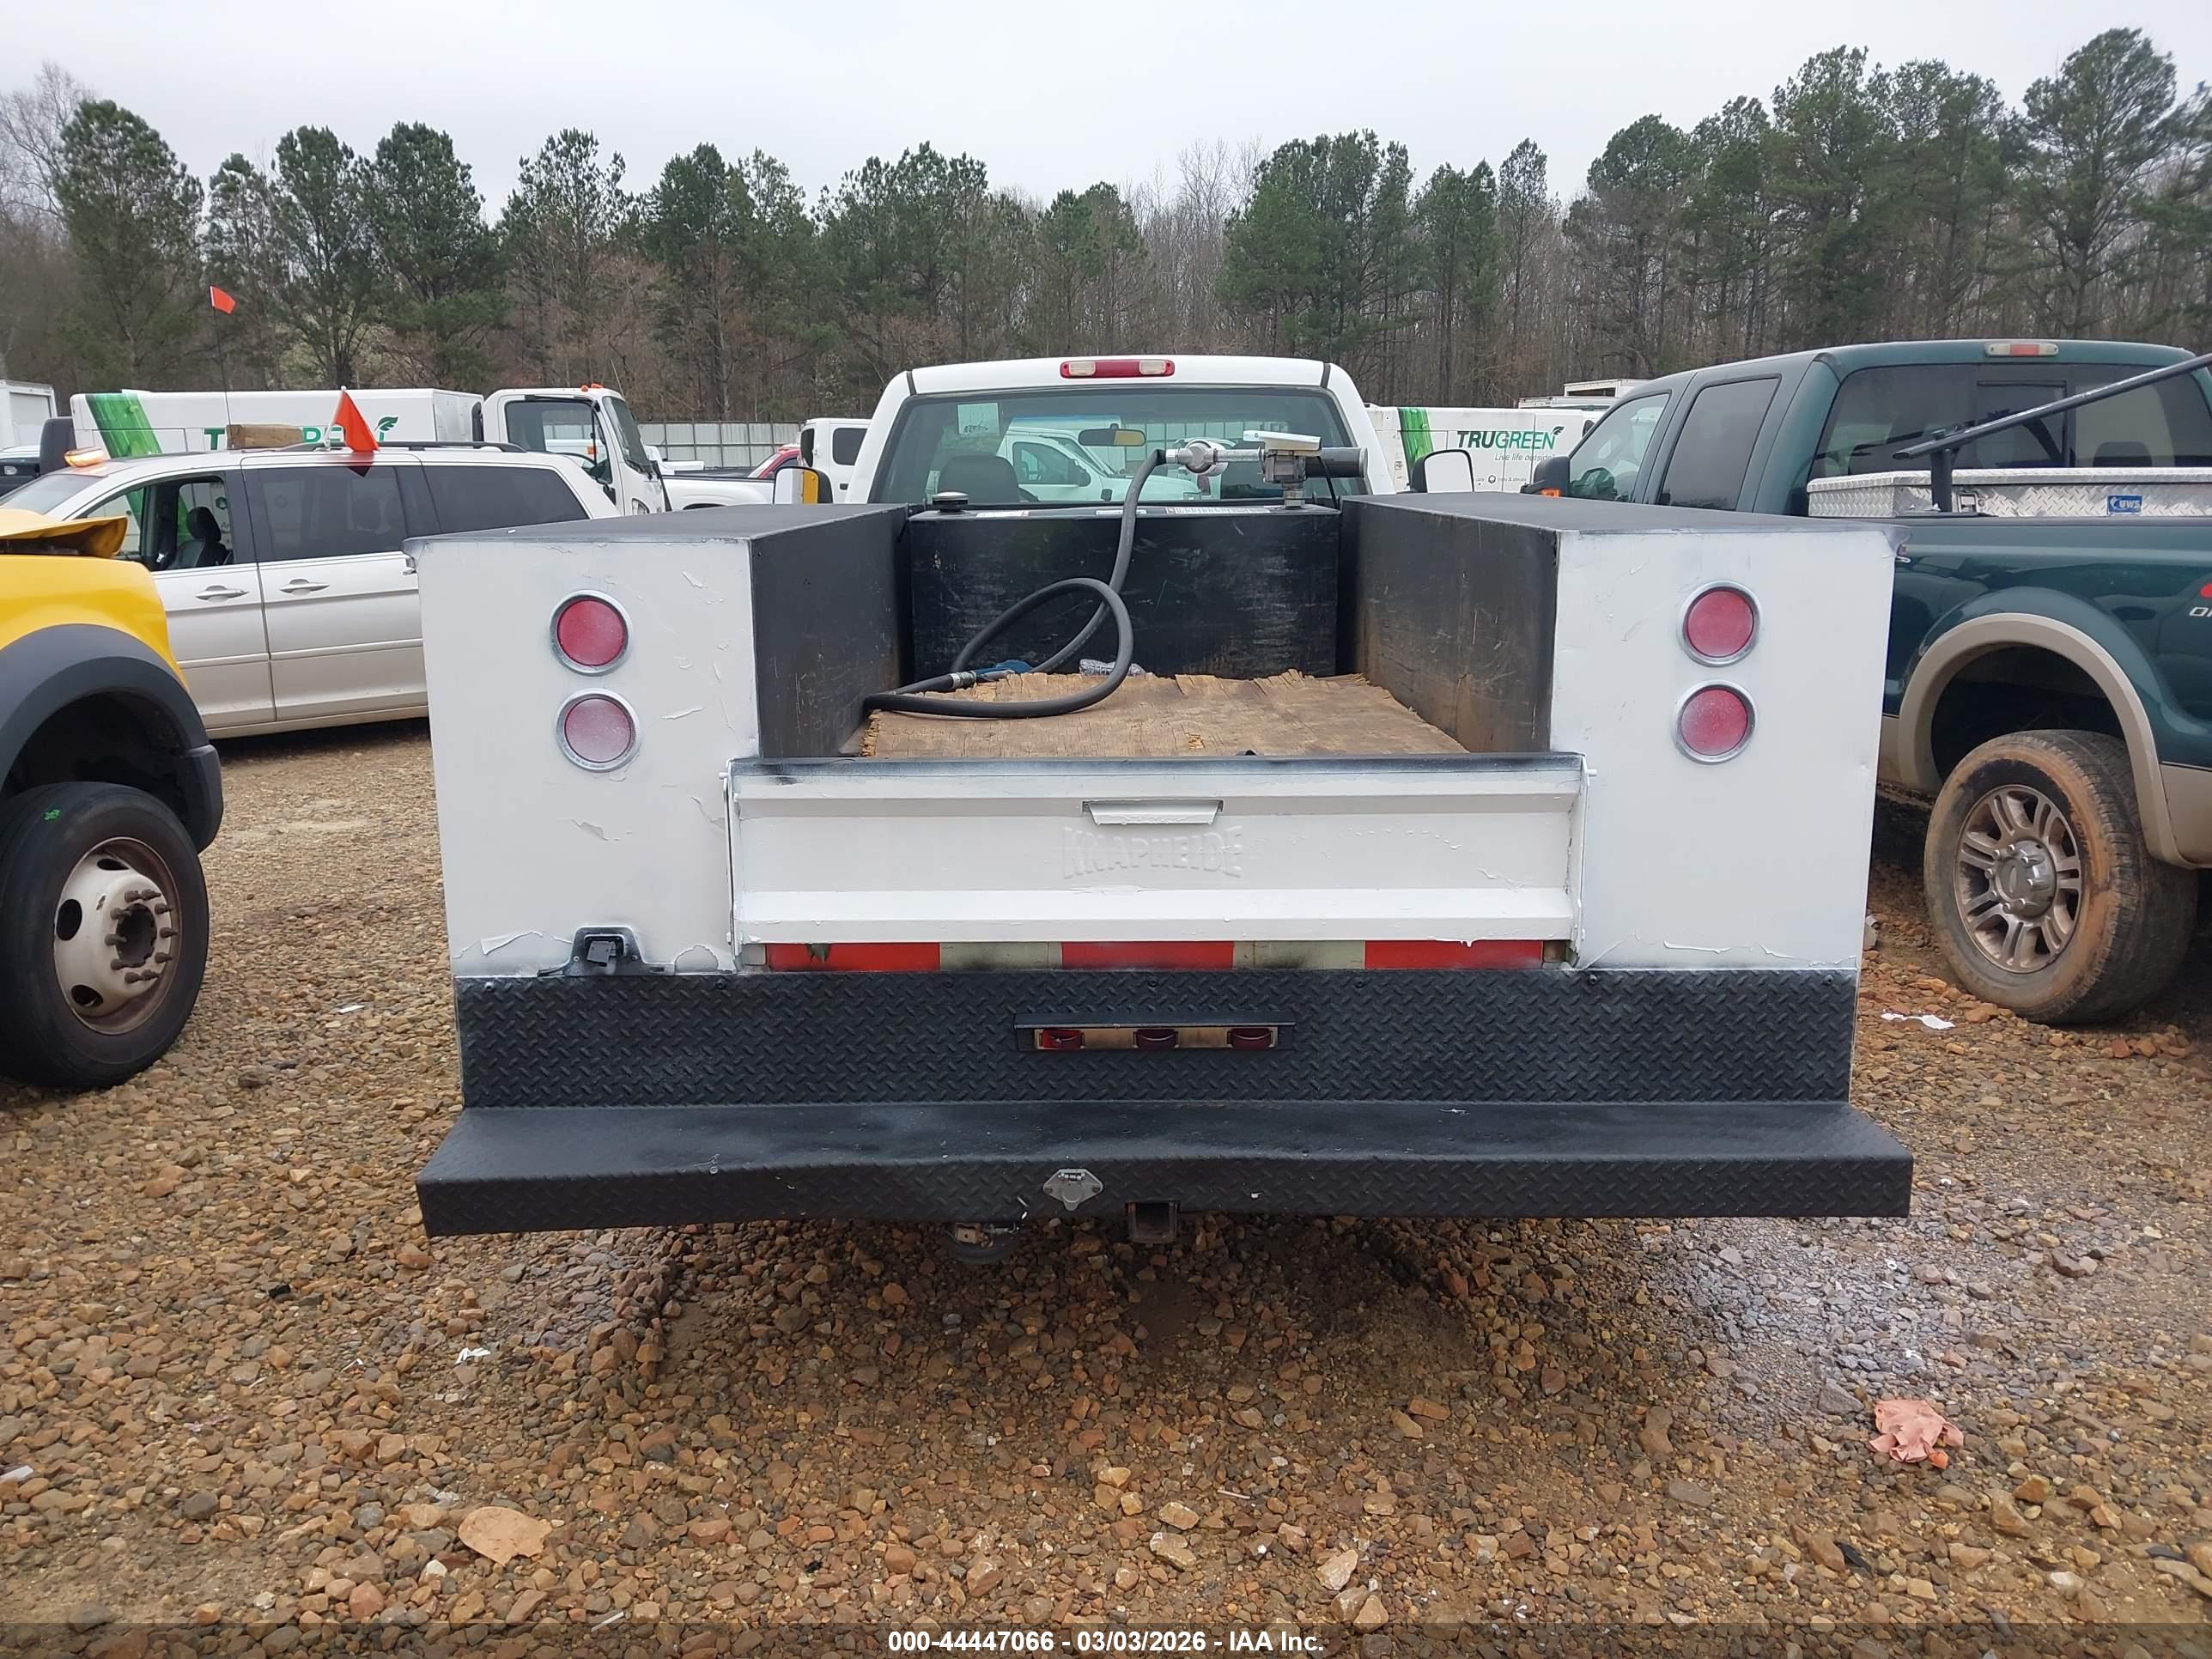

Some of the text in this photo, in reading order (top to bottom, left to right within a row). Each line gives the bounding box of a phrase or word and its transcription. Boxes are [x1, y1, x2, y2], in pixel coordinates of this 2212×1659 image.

[1457, 430, 1556, 450] TRUGREEN
[1495, 453, 1510, 461] Live
[1511, 453, 1523, 461] life
[2119, 500, 2140, 508] UWS
